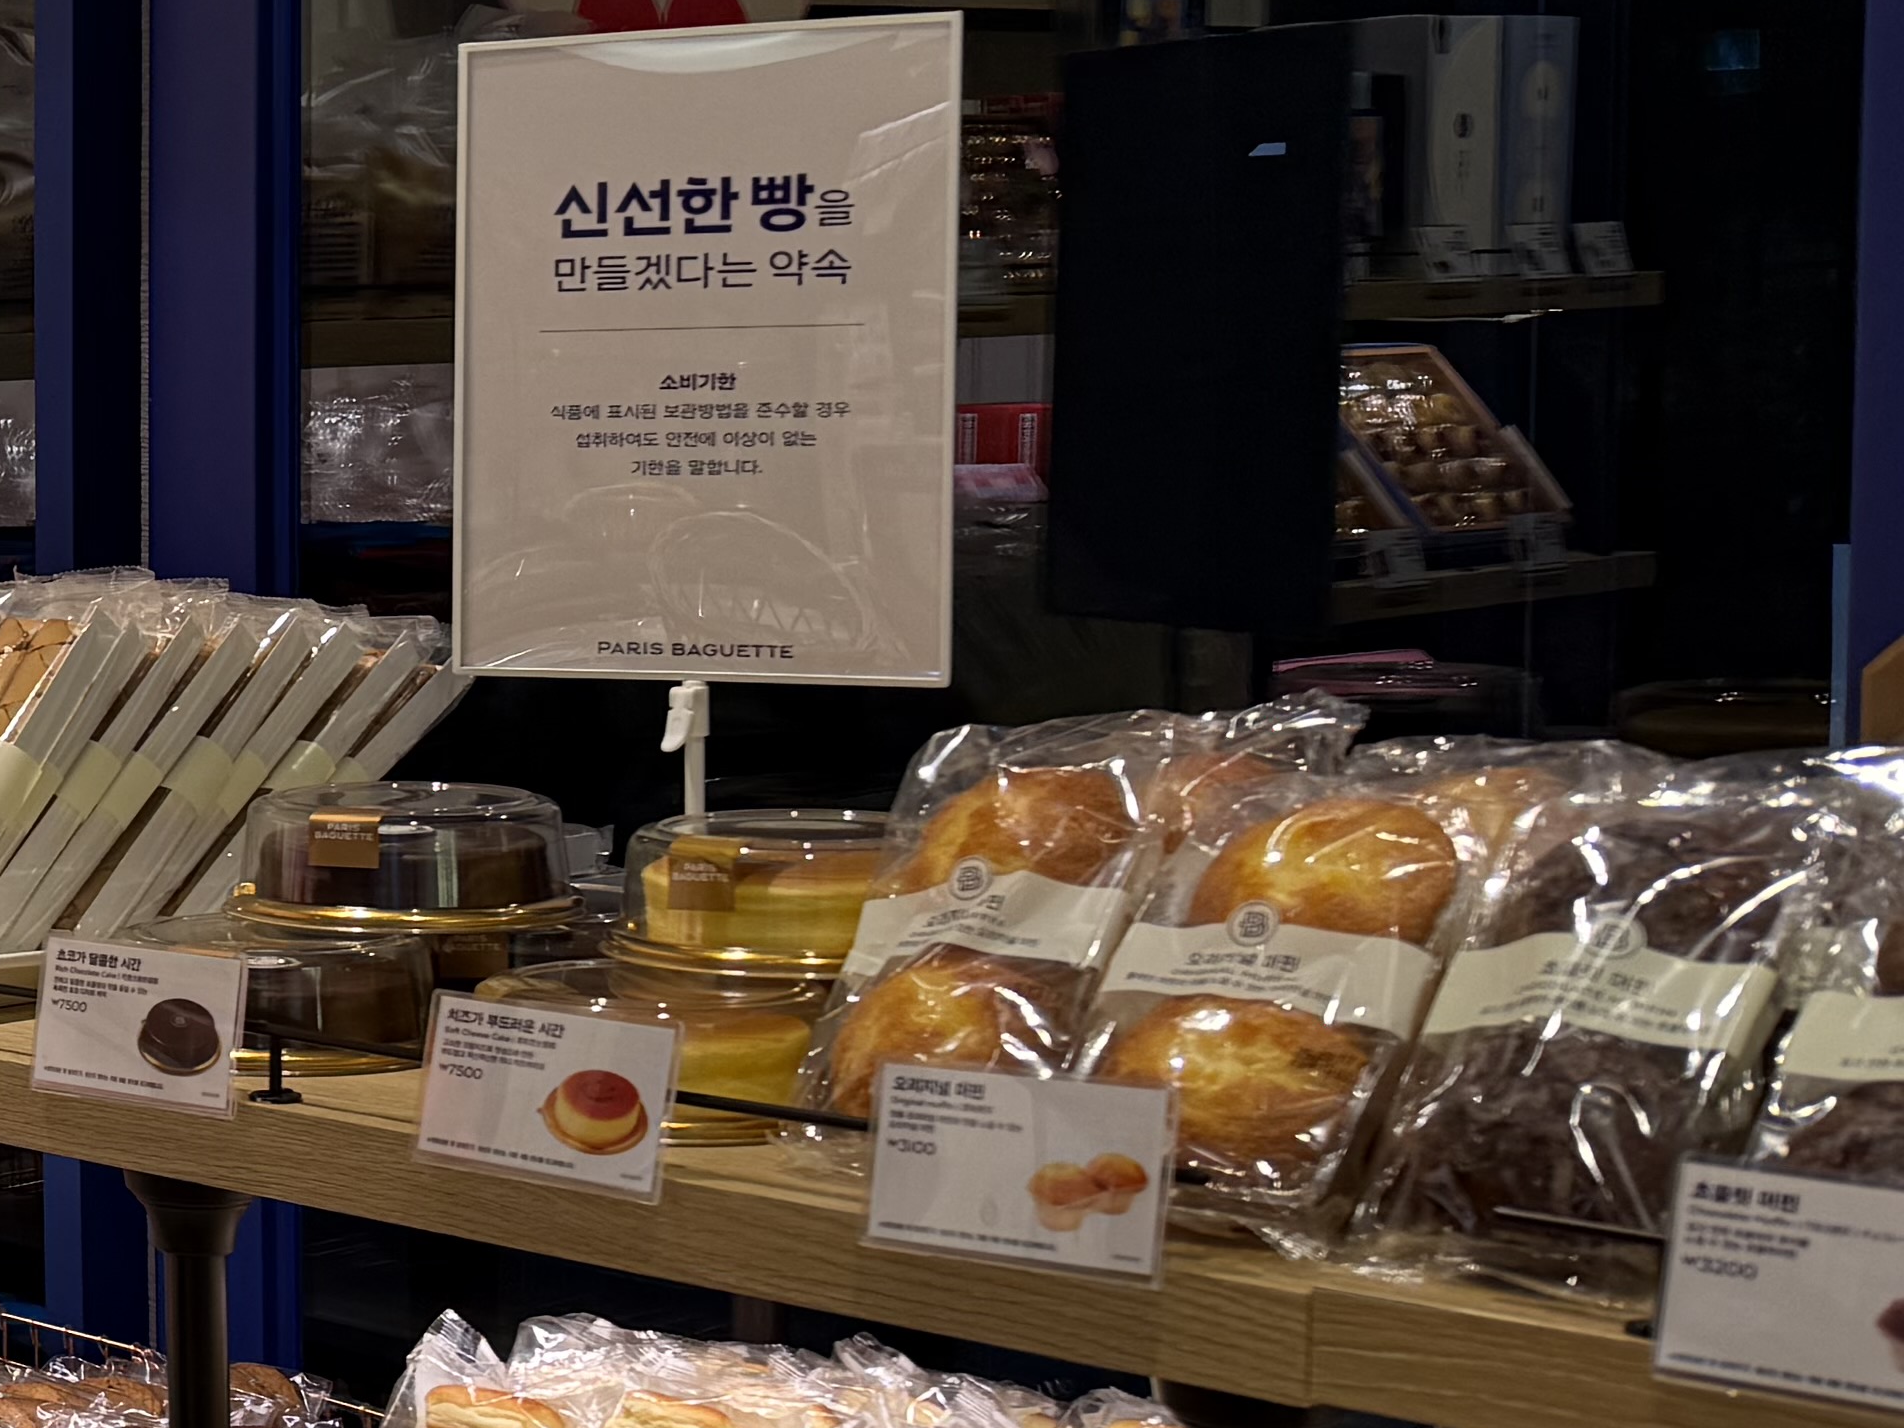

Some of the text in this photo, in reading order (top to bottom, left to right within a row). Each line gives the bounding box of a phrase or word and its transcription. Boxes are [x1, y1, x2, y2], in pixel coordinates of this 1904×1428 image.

[554, 173, 854, 238] 신선한 빵을
[554, 249, 851, 292] 만들겠다는 약속
[659, 373, 737, 391] 소비기한
[551, 401, 850, 420] 식품에 표시된 보관방법을 준수할 경우
[576, 430, 817, 448] 섭취하여도 안전에 이상이 없는
[631, 459, 763, 476] 기한을 말합니다.
[597, 641, 795, 659] PARIS BAGUETTE
[313, 830, 375, 843] BAGUETTE
[326, 822, 362, 833] PARIS
[683, 862, 716, 874] PARIS
[670, 871, 730, 884] BAGUETTE
[56, 948, 142, 972] 초코가 달콤한 시간
[446, 1007, 565, 1040] 치즈가 부드러운 시간
